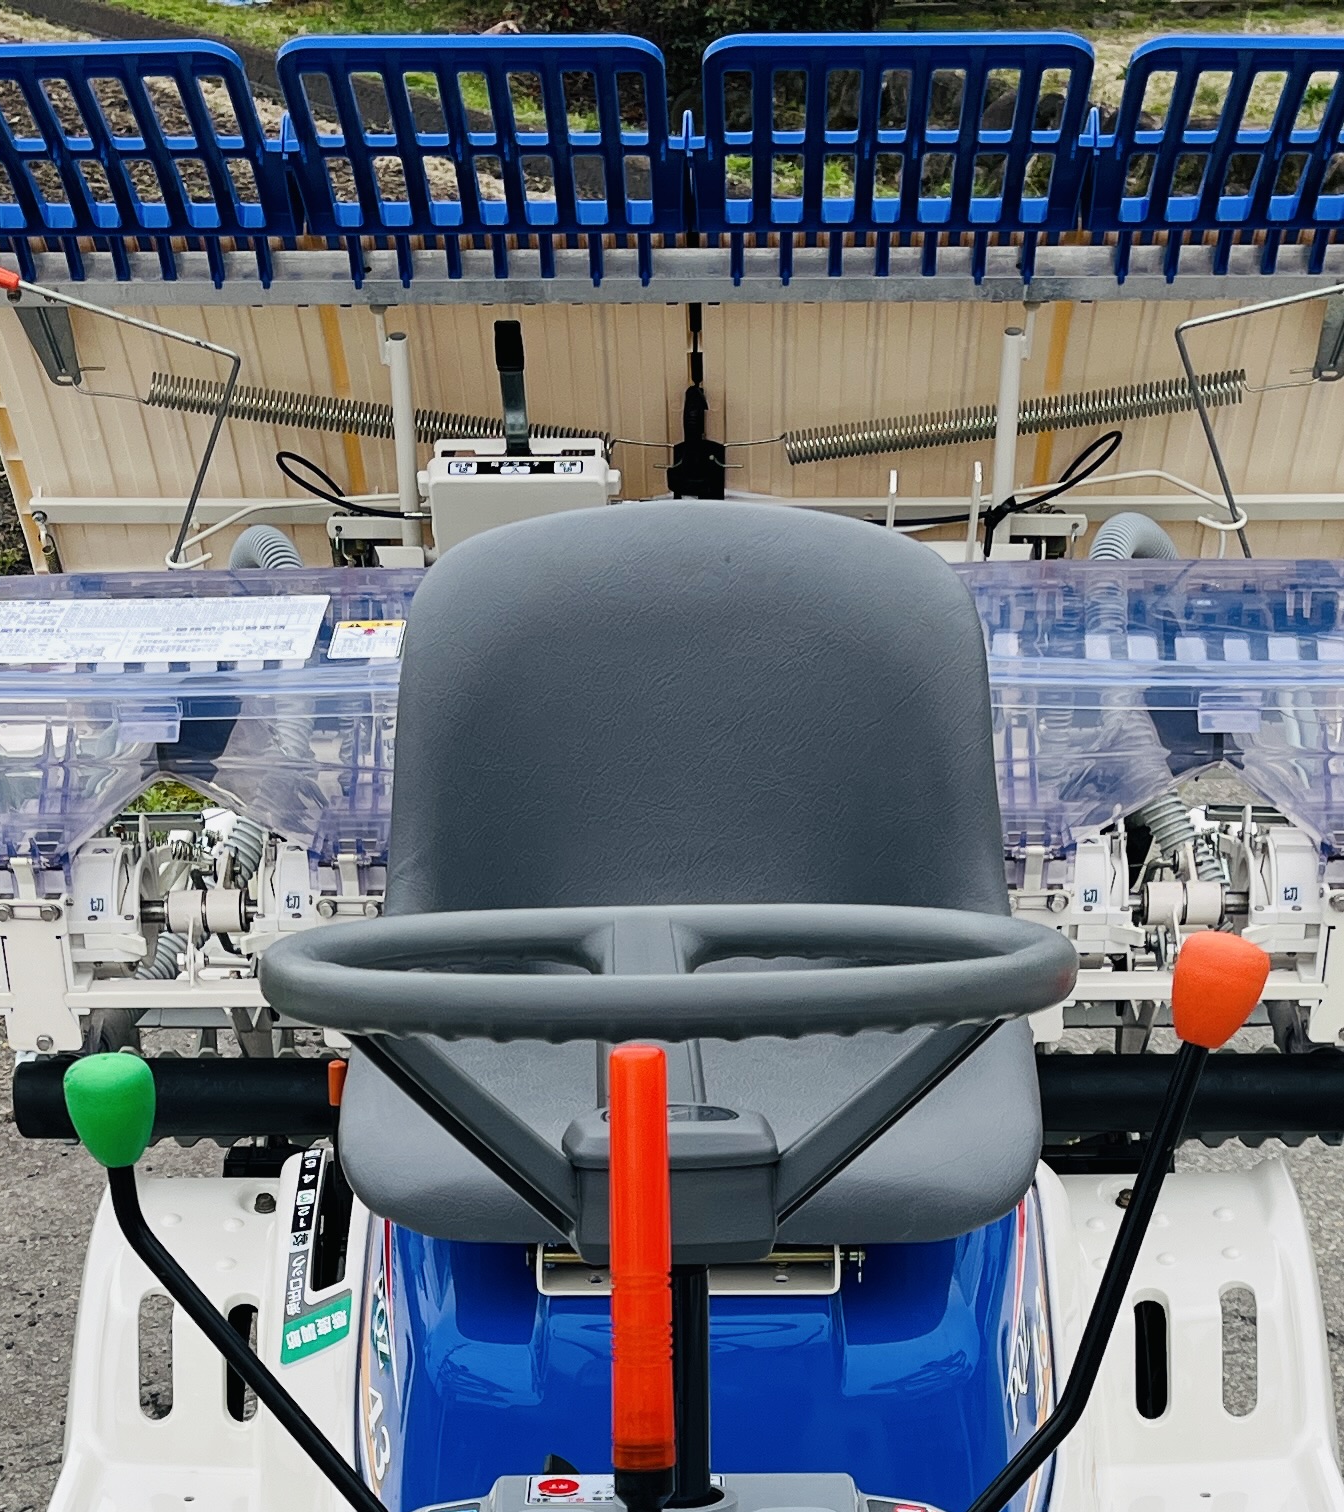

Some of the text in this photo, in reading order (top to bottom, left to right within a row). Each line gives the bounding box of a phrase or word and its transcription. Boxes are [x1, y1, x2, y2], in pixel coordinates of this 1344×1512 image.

[285, 894, 300, 910] 切
[1083, 888, 1098, 904] 切
[1283, 886, 1298, 902] 切
[90, 897, 105, 912] 切
[301, 1173, 316, 1184] 4
[299, 1192, 312, 1203] 3
[285, 1254, 308, 1316] 油圧ロック
